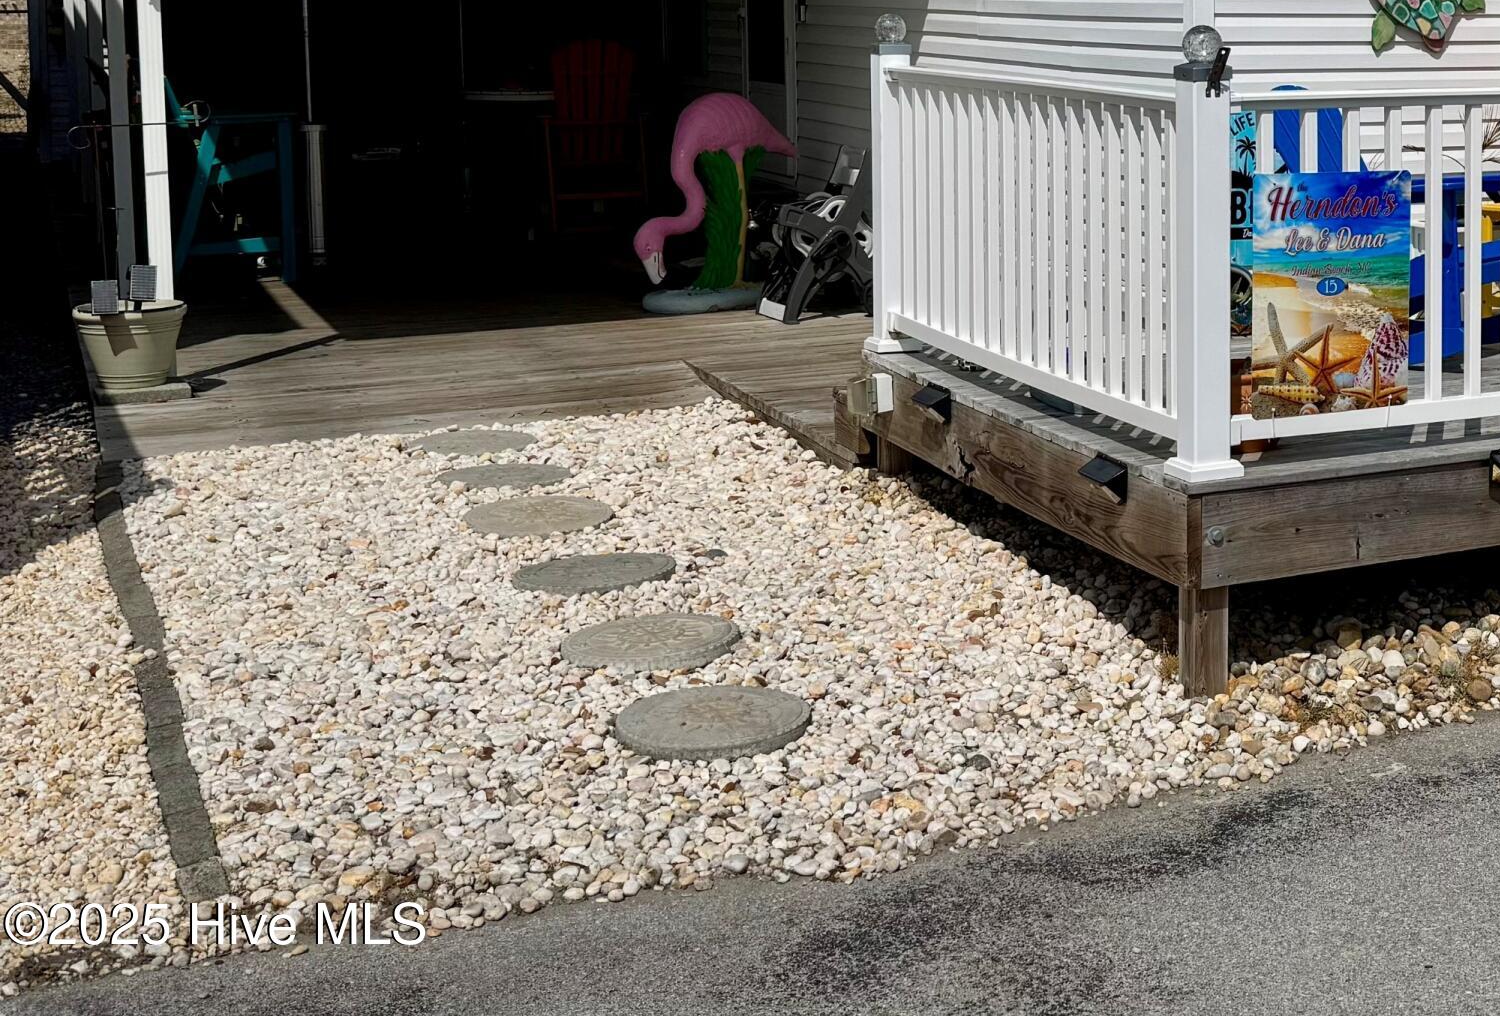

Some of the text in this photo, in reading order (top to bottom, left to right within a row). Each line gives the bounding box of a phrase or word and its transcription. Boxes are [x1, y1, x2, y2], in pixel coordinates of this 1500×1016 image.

[1230, 112, 1255, 136] LIFE
[1268, 184, 1398, 222] Herndon's
[1284, 227, 1386, 257] Lee & Dana
[1324, 279, 1338, 294] 15
